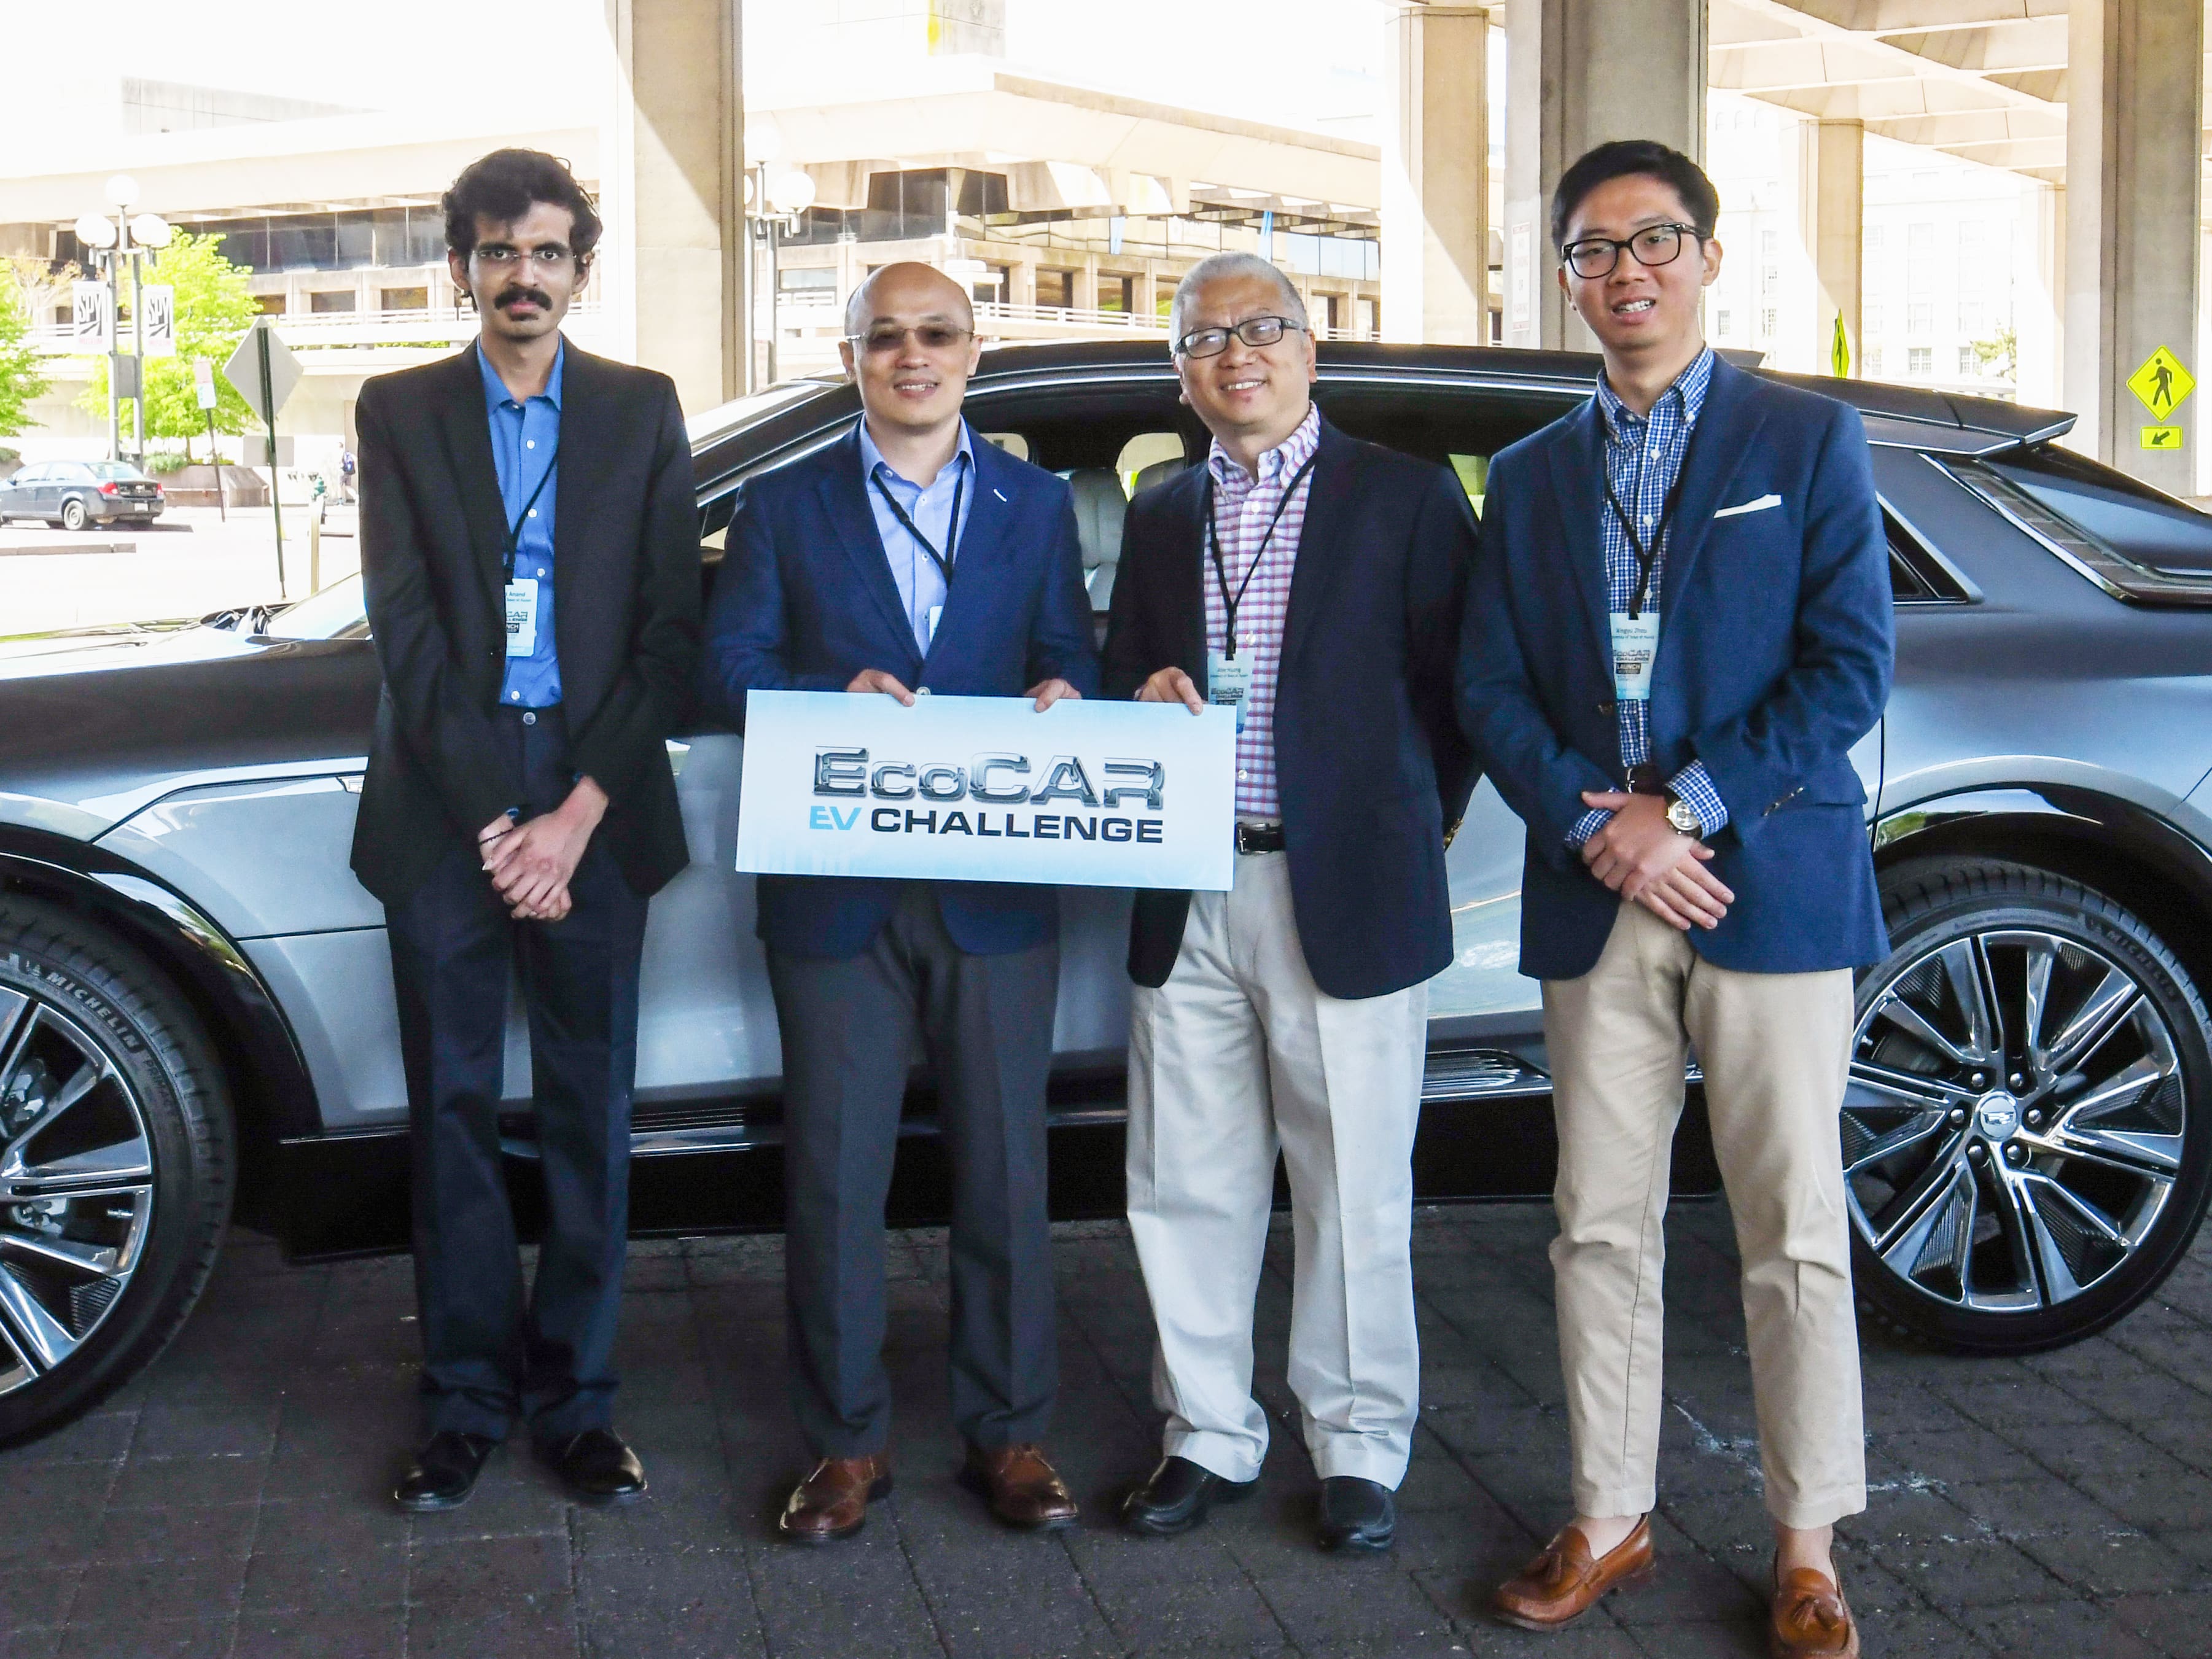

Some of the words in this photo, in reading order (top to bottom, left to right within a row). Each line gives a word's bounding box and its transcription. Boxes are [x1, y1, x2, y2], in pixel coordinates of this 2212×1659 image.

[79, 293, 103, 326] SPY
[149, 297, 171, 327] SPY
[812, 745, 1166, 810] EcoCAR
[809, 806, 862, 831] EV
[871, 807, 1164, 844] CHALLENGE
[46, 972, 140, 1048] MICHELIN
